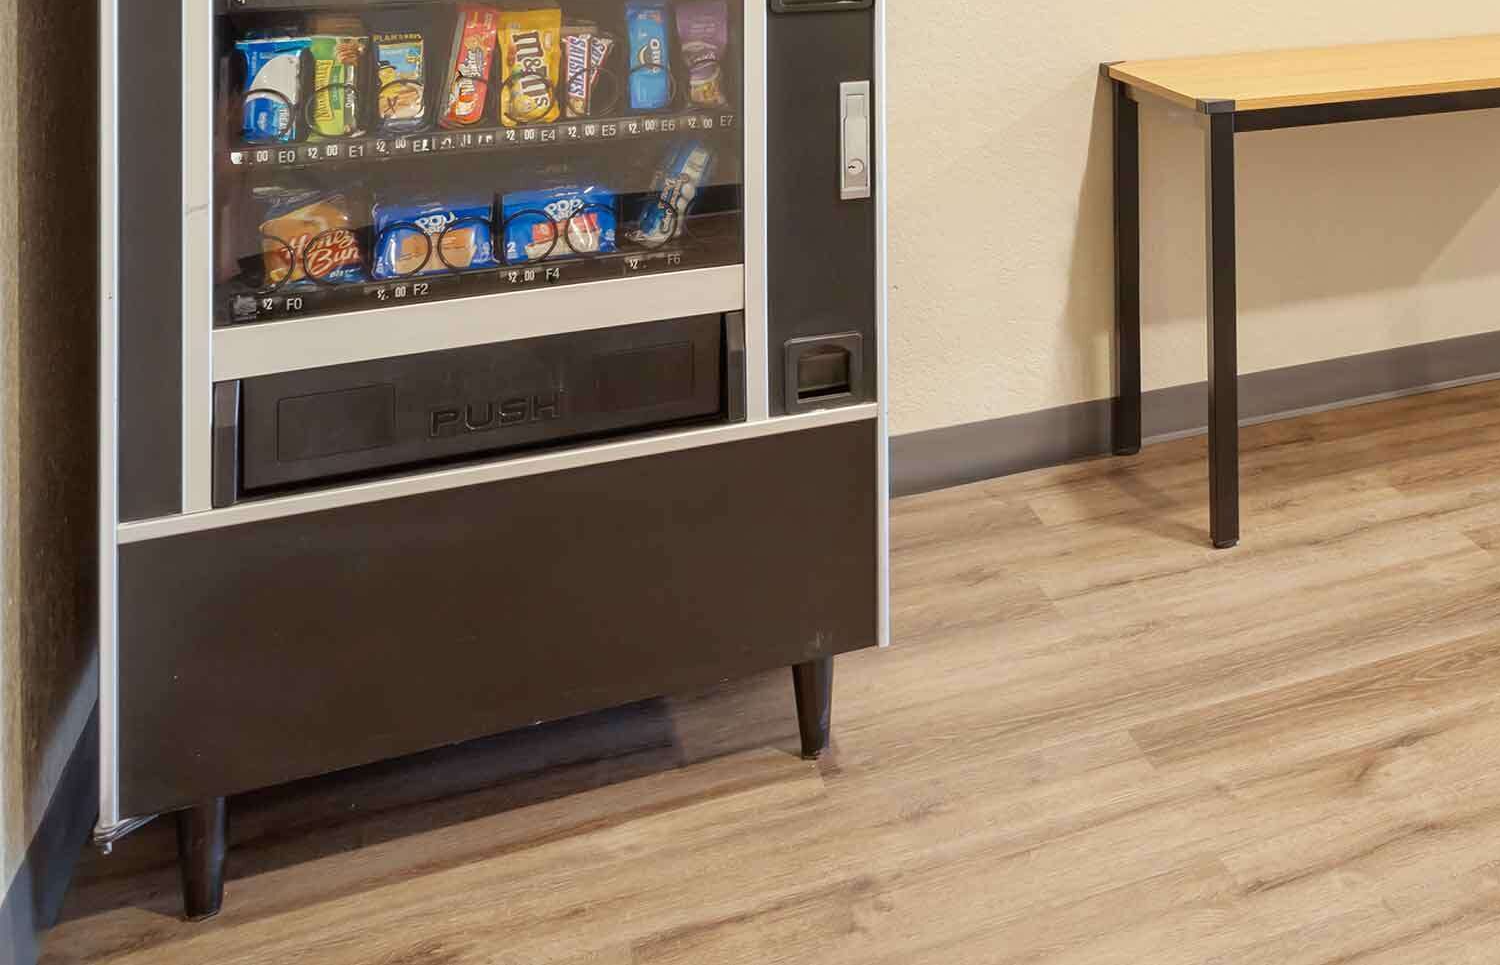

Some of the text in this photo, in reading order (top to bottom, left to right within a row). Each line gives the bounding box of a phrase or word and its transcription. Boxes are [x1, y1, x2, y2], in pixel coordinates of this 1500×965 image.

[542, 130, 555, 141] E4
[602, 125, 616, 136] E5
[278, 150, 295, 163] E0
[350, 145, 363, 157] E1
[306, 247, 360, 276] Bun
[545, 267, 560, 280] F4
[413, 283, 428, 296] F2
[286, 298, 303, 311] F0
[428, 389, 563, 438] PUSH
